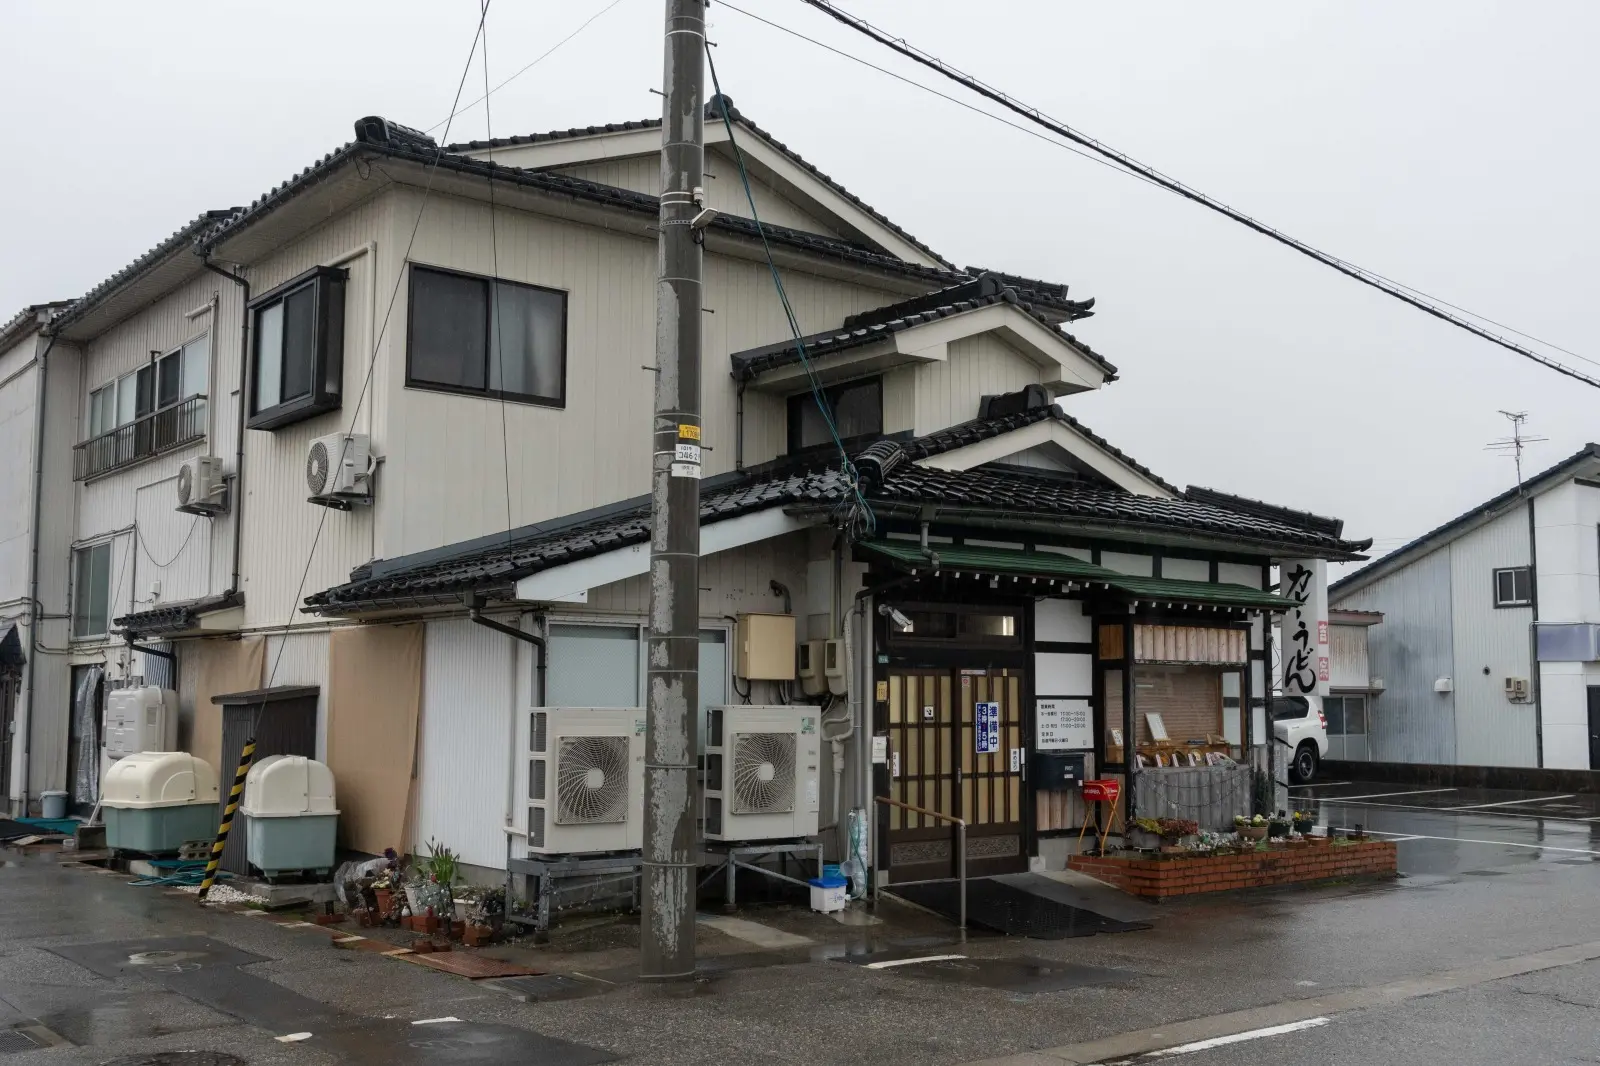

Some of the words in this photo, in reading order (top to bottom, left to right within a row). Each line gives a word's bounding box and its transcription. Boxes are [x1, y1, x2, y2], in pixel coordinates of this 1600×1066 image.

[1285, 563, 1317, 694] カレーうどん
[989, 705, 998, 748] 準備中
